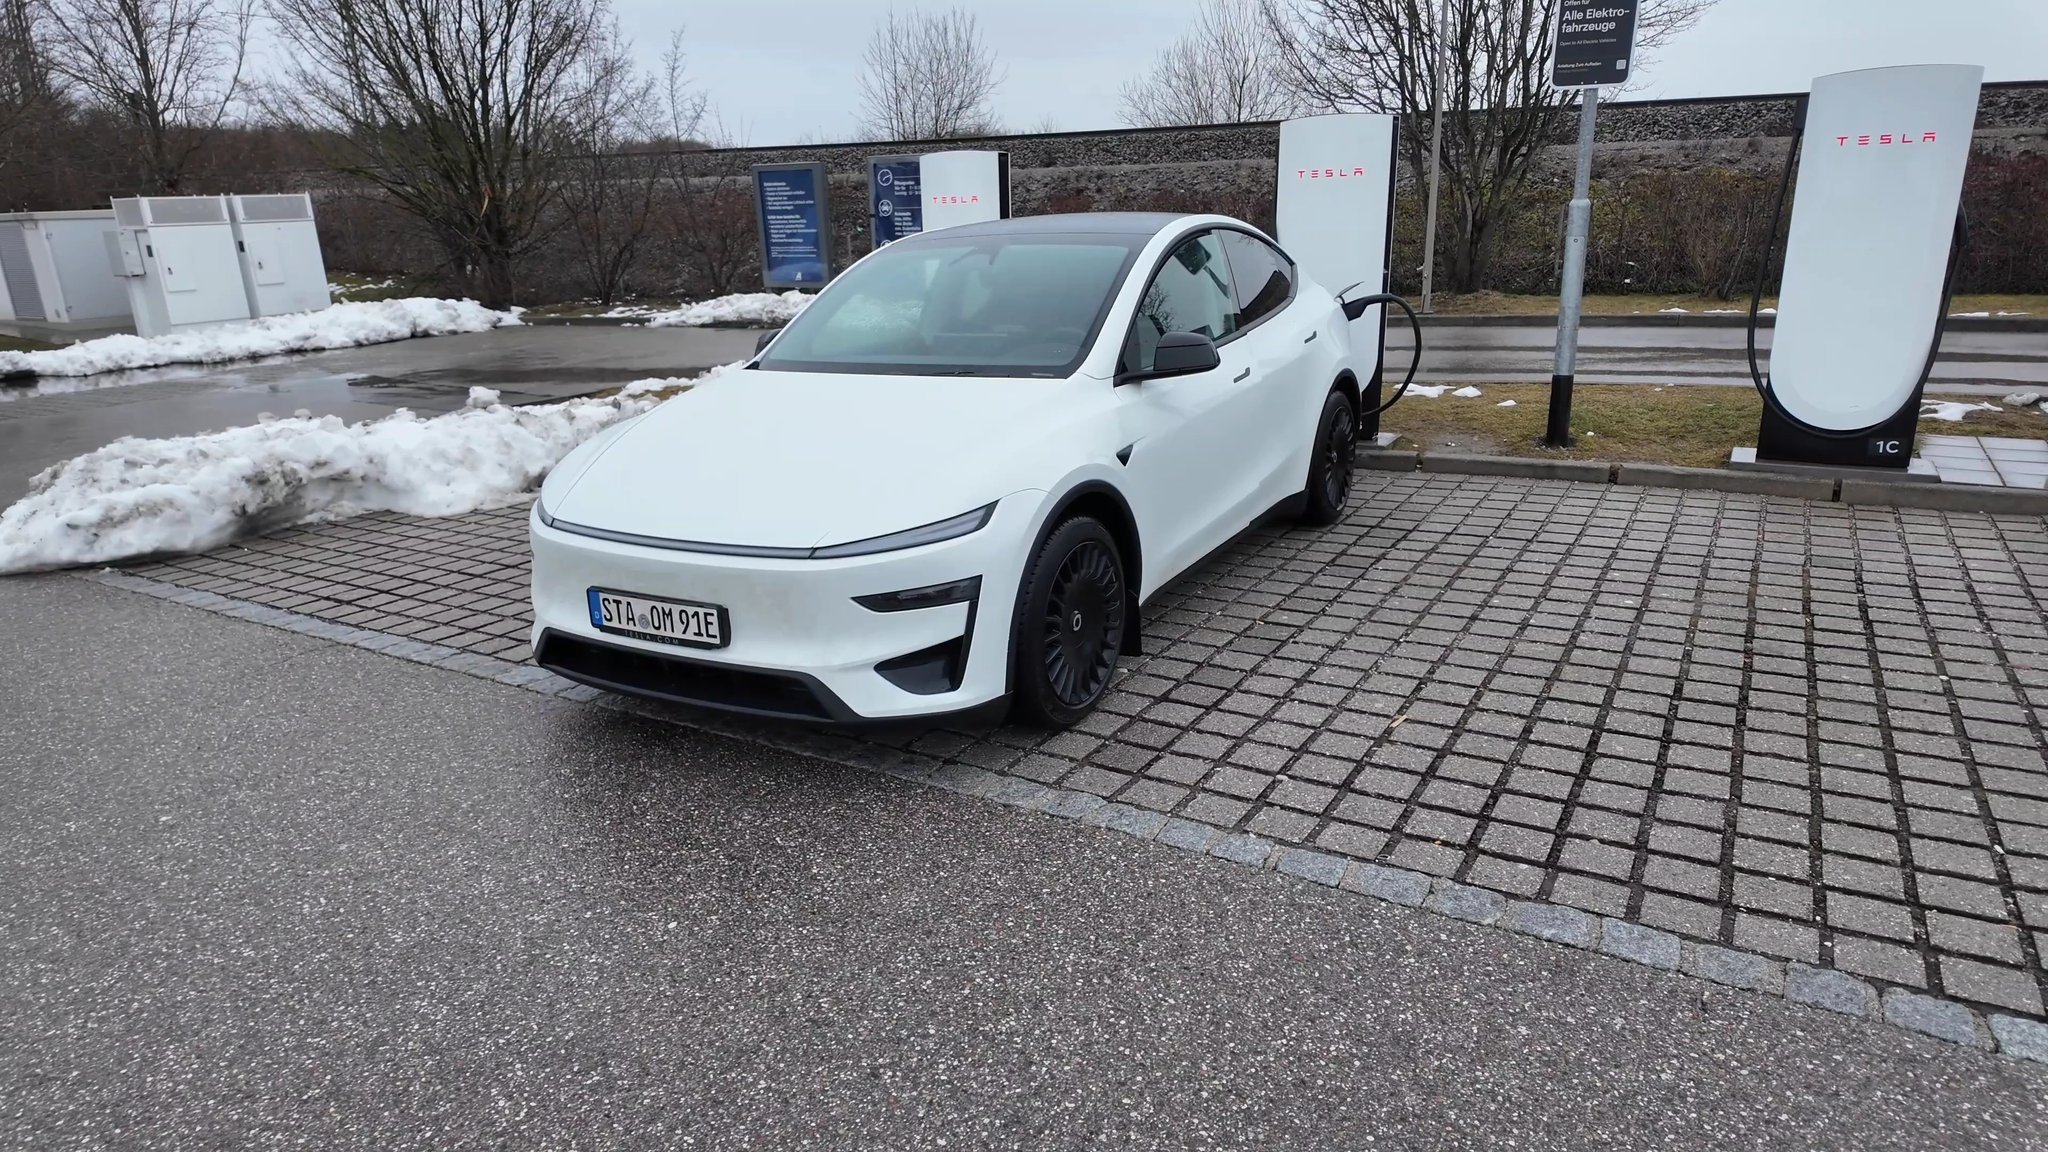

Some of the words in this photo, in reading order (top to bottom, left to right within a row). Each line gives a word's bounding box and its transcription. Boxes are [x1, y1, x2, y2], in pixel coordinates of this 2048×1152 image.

[1563, 10, 1584, 20] Alle
[1586, 8, 1630, 19] Elektro-
[1562, 21, 1616, 33] fahrzeuge
[1836, 132, 1936, 146] TESLA
[1298, 167, 1363, 179] TESLA
[933, 195, 978, 204] TESLA
[1876, 440, 1900, 453] 1C
[594, 611, 600, 619] D
[602, 597, 636, 627] STA
[650, 605, 674, 633] OM
[679, 609, 717, 639] 91E
